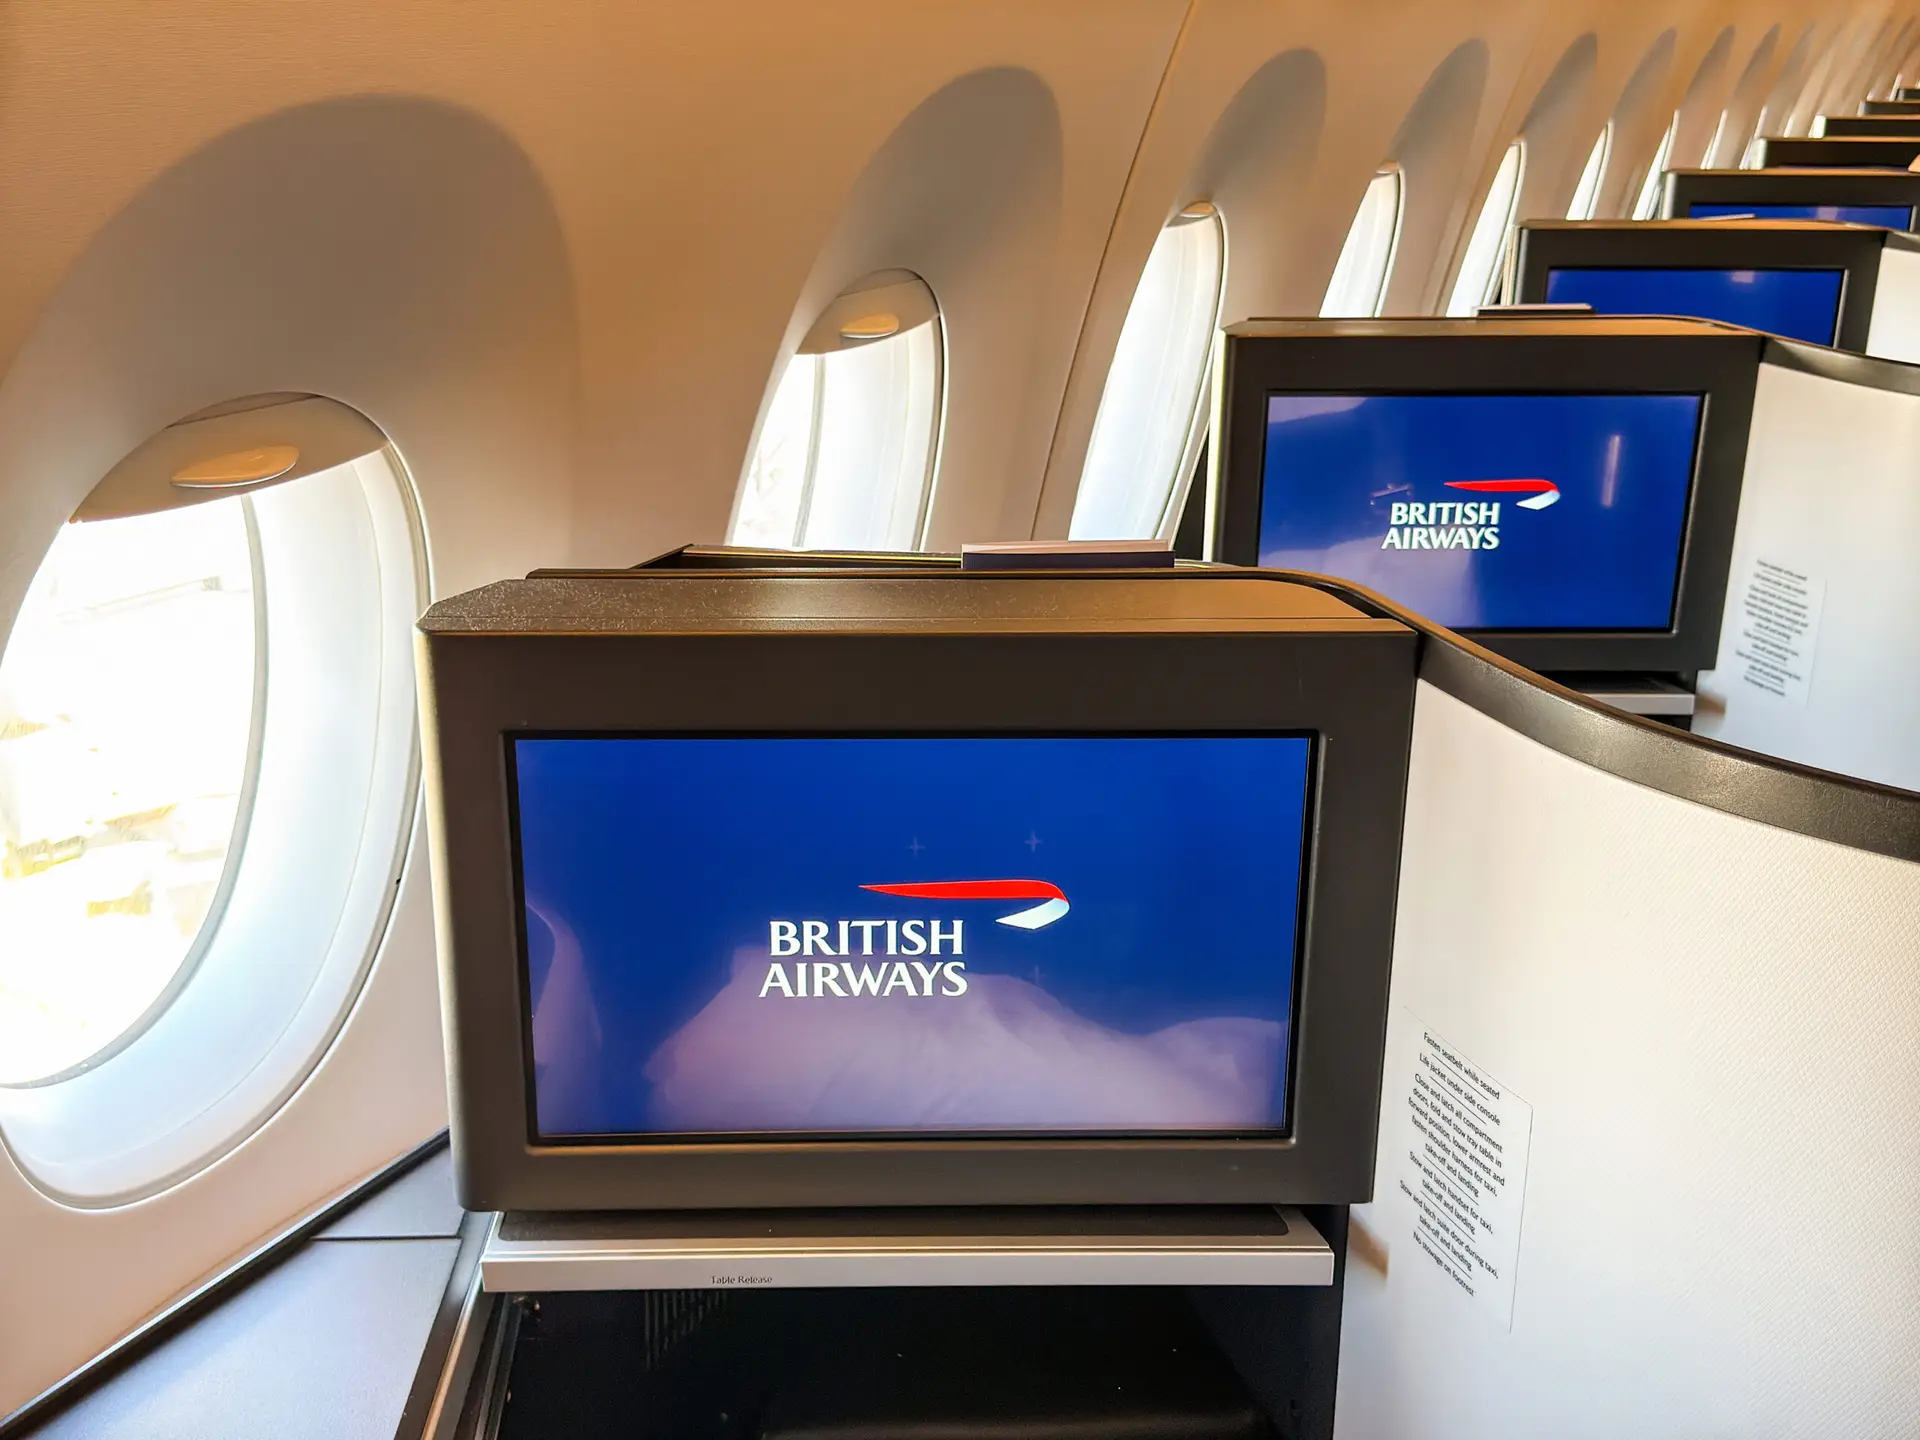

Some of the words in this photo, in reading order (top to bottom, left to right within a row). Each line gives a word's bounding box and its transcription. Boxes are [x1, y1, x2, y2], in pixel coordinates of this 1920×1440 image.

[1381, 526, 1500, 550] AIRWAYS
[1390, 502, 1501, 525] BRITISH
[769, 920, 964, 956] BRITISH
[758, 961, 969, 998] AIRWAYS
[1420, 1052, 1429, 1067] Life
[1430, 1062, 1446, 1082] jacket
[1447, 1078, 1463, 1095] under
[1464, 1092, 1476, 1106] side
[1477, 1104, 1500, 1126] console
[1424, 1032, 1440, 1052] Fasten
[1442, 1049, 1463, 1070] seatbelt
[1464, 1067, 1479, 1083] while
[1480, 1080, 1500, 1100] seated
[1408, 1097, 1428, 1120] forward
[1429, 1117, 1451, 1142] position,
[1452, 1136, 1468, 1155] lower
[1469, 1153, 1491, 1176] armrest
[1492, 1173, 1504, 1186] and
[1413, 1088, 1429, 1107] doors,
[1430, 1102, 1440, 1116] fold
[1441, 1113, 1452, 1126] and
[1453, 1124, 1465, 1138] stow
[1466, 1135, 1478, 1149] tray
[1479, 1145, 1494, 1162] table
[1495, 1158, 1501, 1168] in
[1415, 1073, 1429, 1091] Close
[1430, 1088, 1440, 1101] and
[1441, 1096, 1454, 1112] latch
[1463, 1117, 1502, 1153] compartment
[1412, 1115, 1427, 1134] fasten
[1428, 1132, 1451, 1155] shoulder
[1452, 1151, 1473, 1176] harness
[1474, 1171, 1483, 1183] for
[1425, 1143, 1446, 1166] take-off
[1447, 1164, 1457, 1176] and
[1410, 1151, 1422, 1168] Stow
[1423, 1166, 1433, 1179] and
[1434, 1174, 1446, 1191] latch
[1448, 1187, 1469, 1212] handset
[1470, 1208, 1478, 1220] for
[1422, 1179, 1443, 1202] take-off
[1443, 1200, 1453, 1213] and
[1400, 1180, 1412, 1196] Stow
[1413, 1195, 1422, 1207] and
[1423, 1203, 1436, 1220] latch
[1437, 1218, 1449, 1234] suite
[1450, 1231, 1464, 1246] door
[1465, 1245, 1484, 1267] during
[1420, 1215, 1440, 1239] take-off
[1440, 1236, 1450, 1249] and
[711, 1275, 736, 1284] Table
[738, 1276, 773, 1284] Release
[1414, 1232, 1421, 1244] No
[1422, 1242, 1443, 1267] stowage
[1444, 1264, 1451, 1275] on
[1452, 1270, 1474, 1297] footrest
